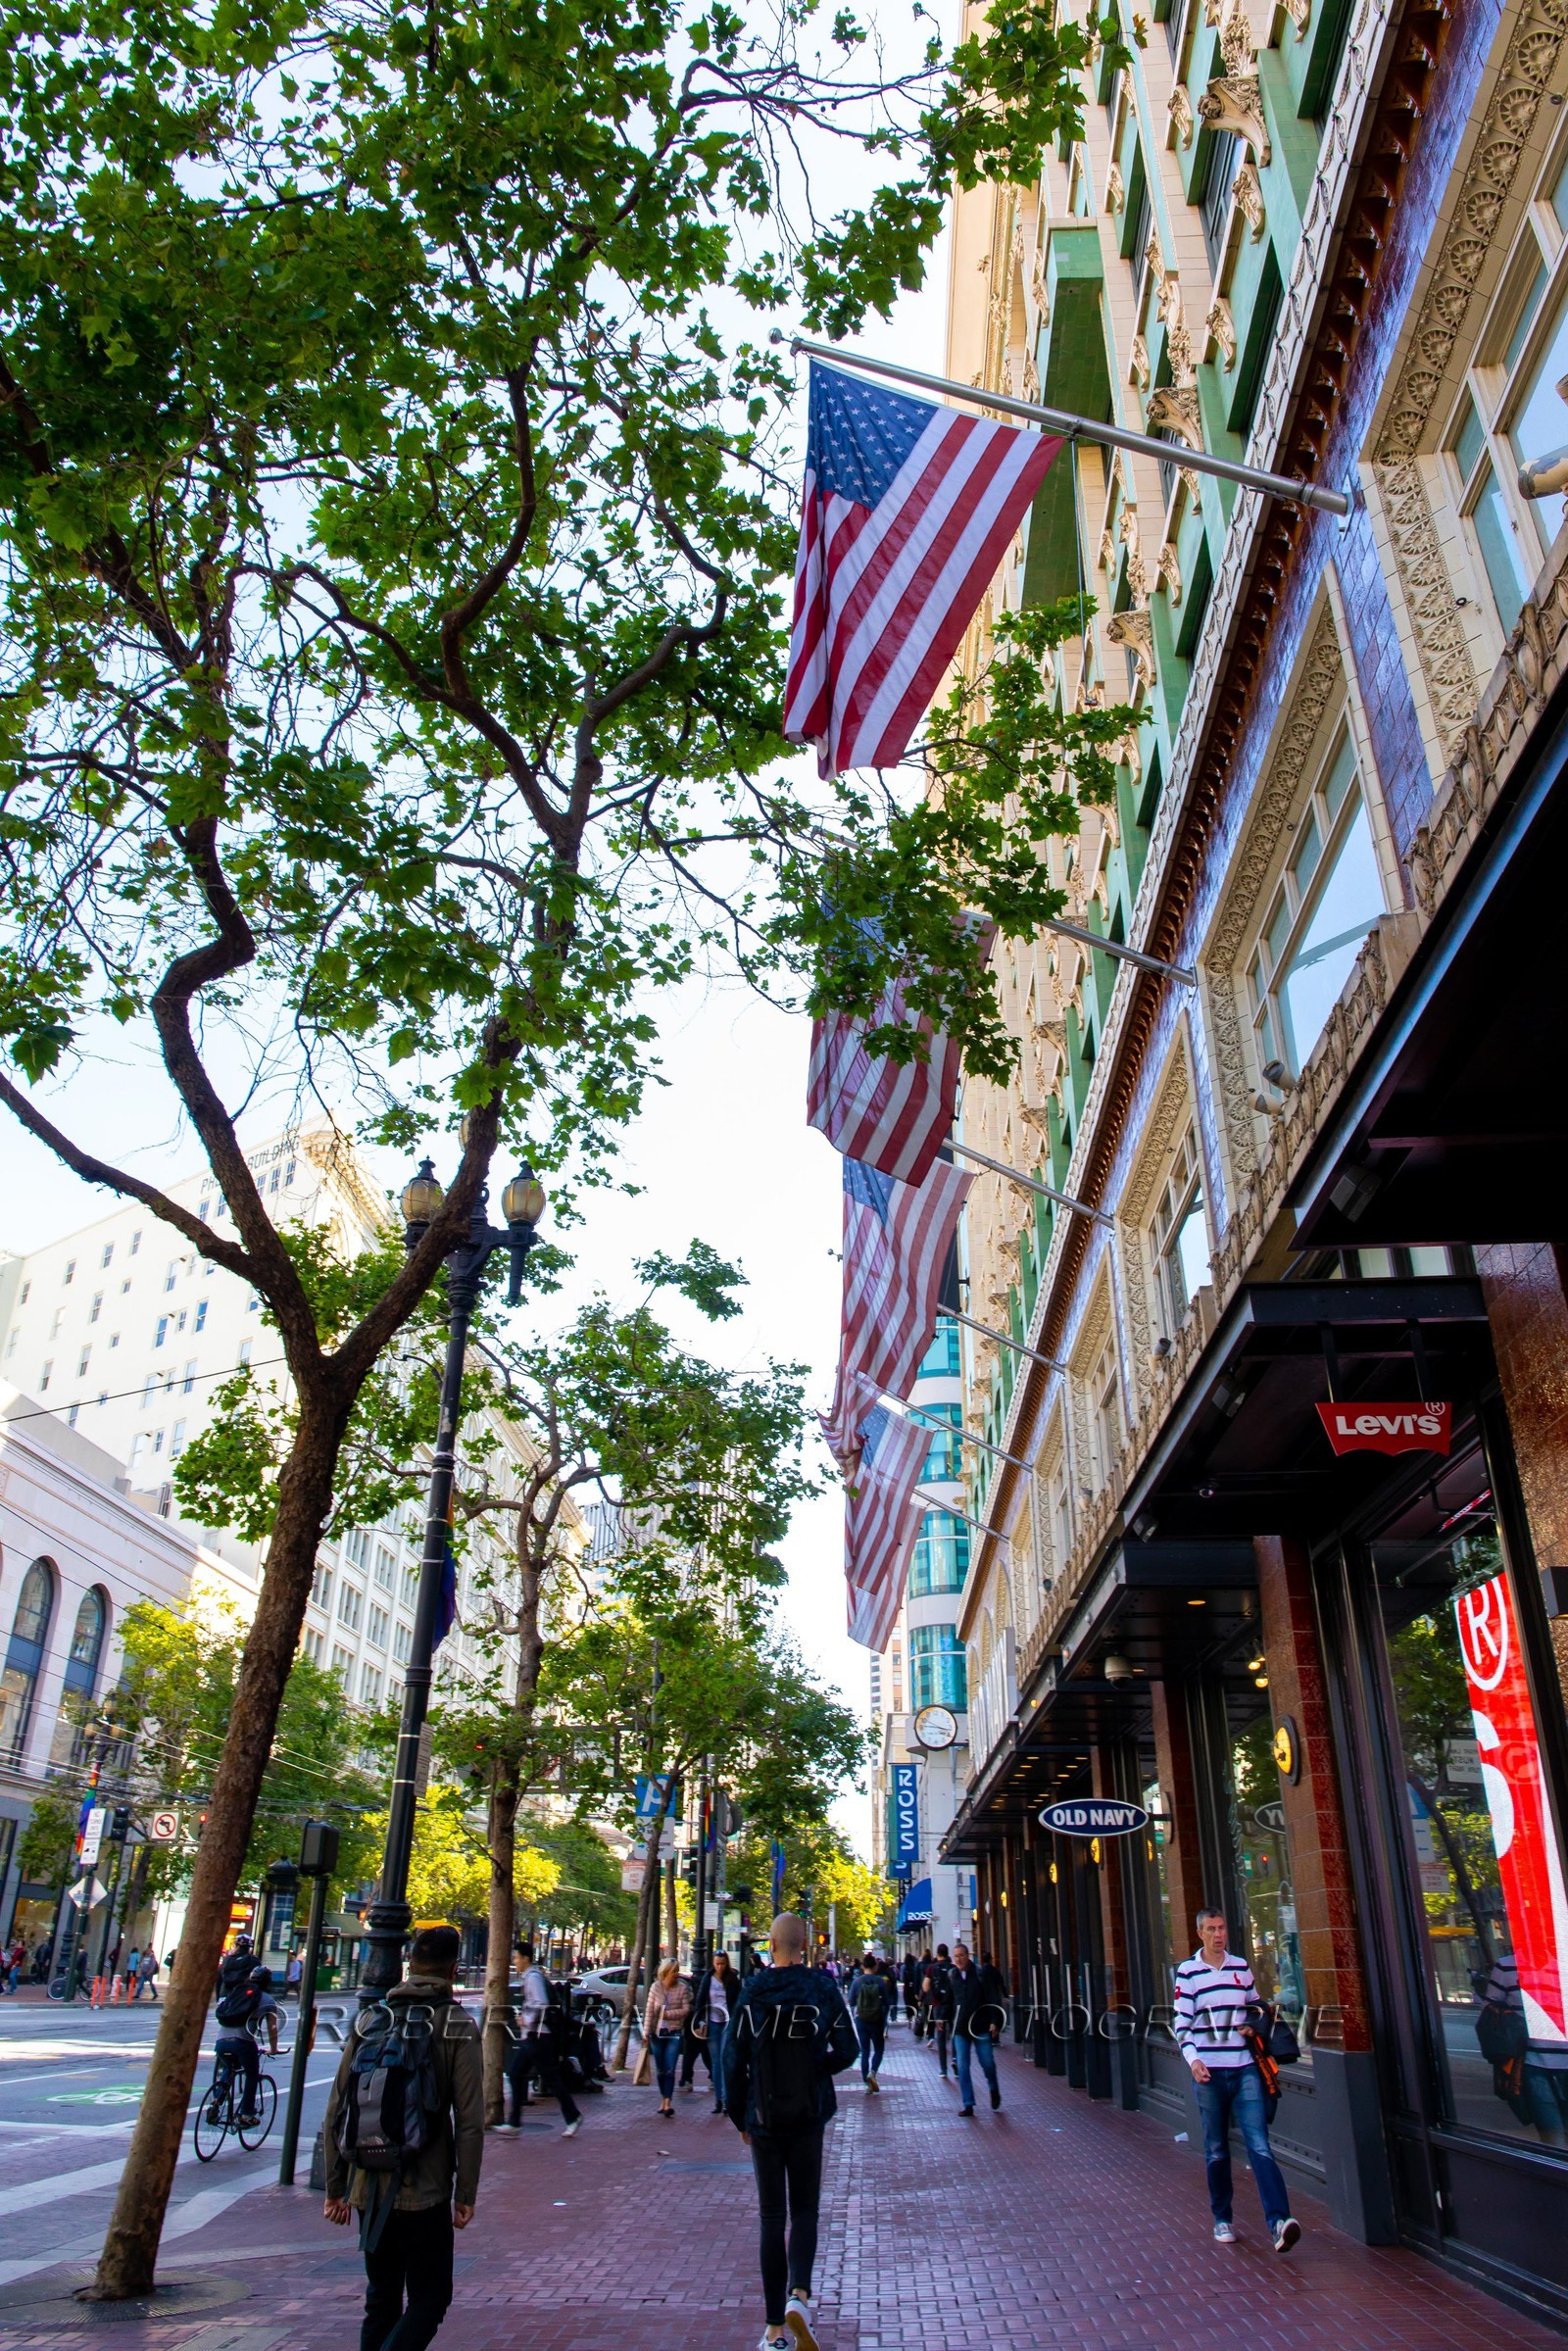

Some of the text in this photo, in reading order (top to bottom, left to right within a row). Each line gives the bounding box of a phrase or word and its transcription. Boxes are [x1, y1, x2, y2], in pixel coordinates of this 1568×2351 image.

[898, 1769, 915, 1850] ROSS
[1052, 1809, 1136, 1826] OLD NAVY
[907, 1912, 933, 1921] ROSS
